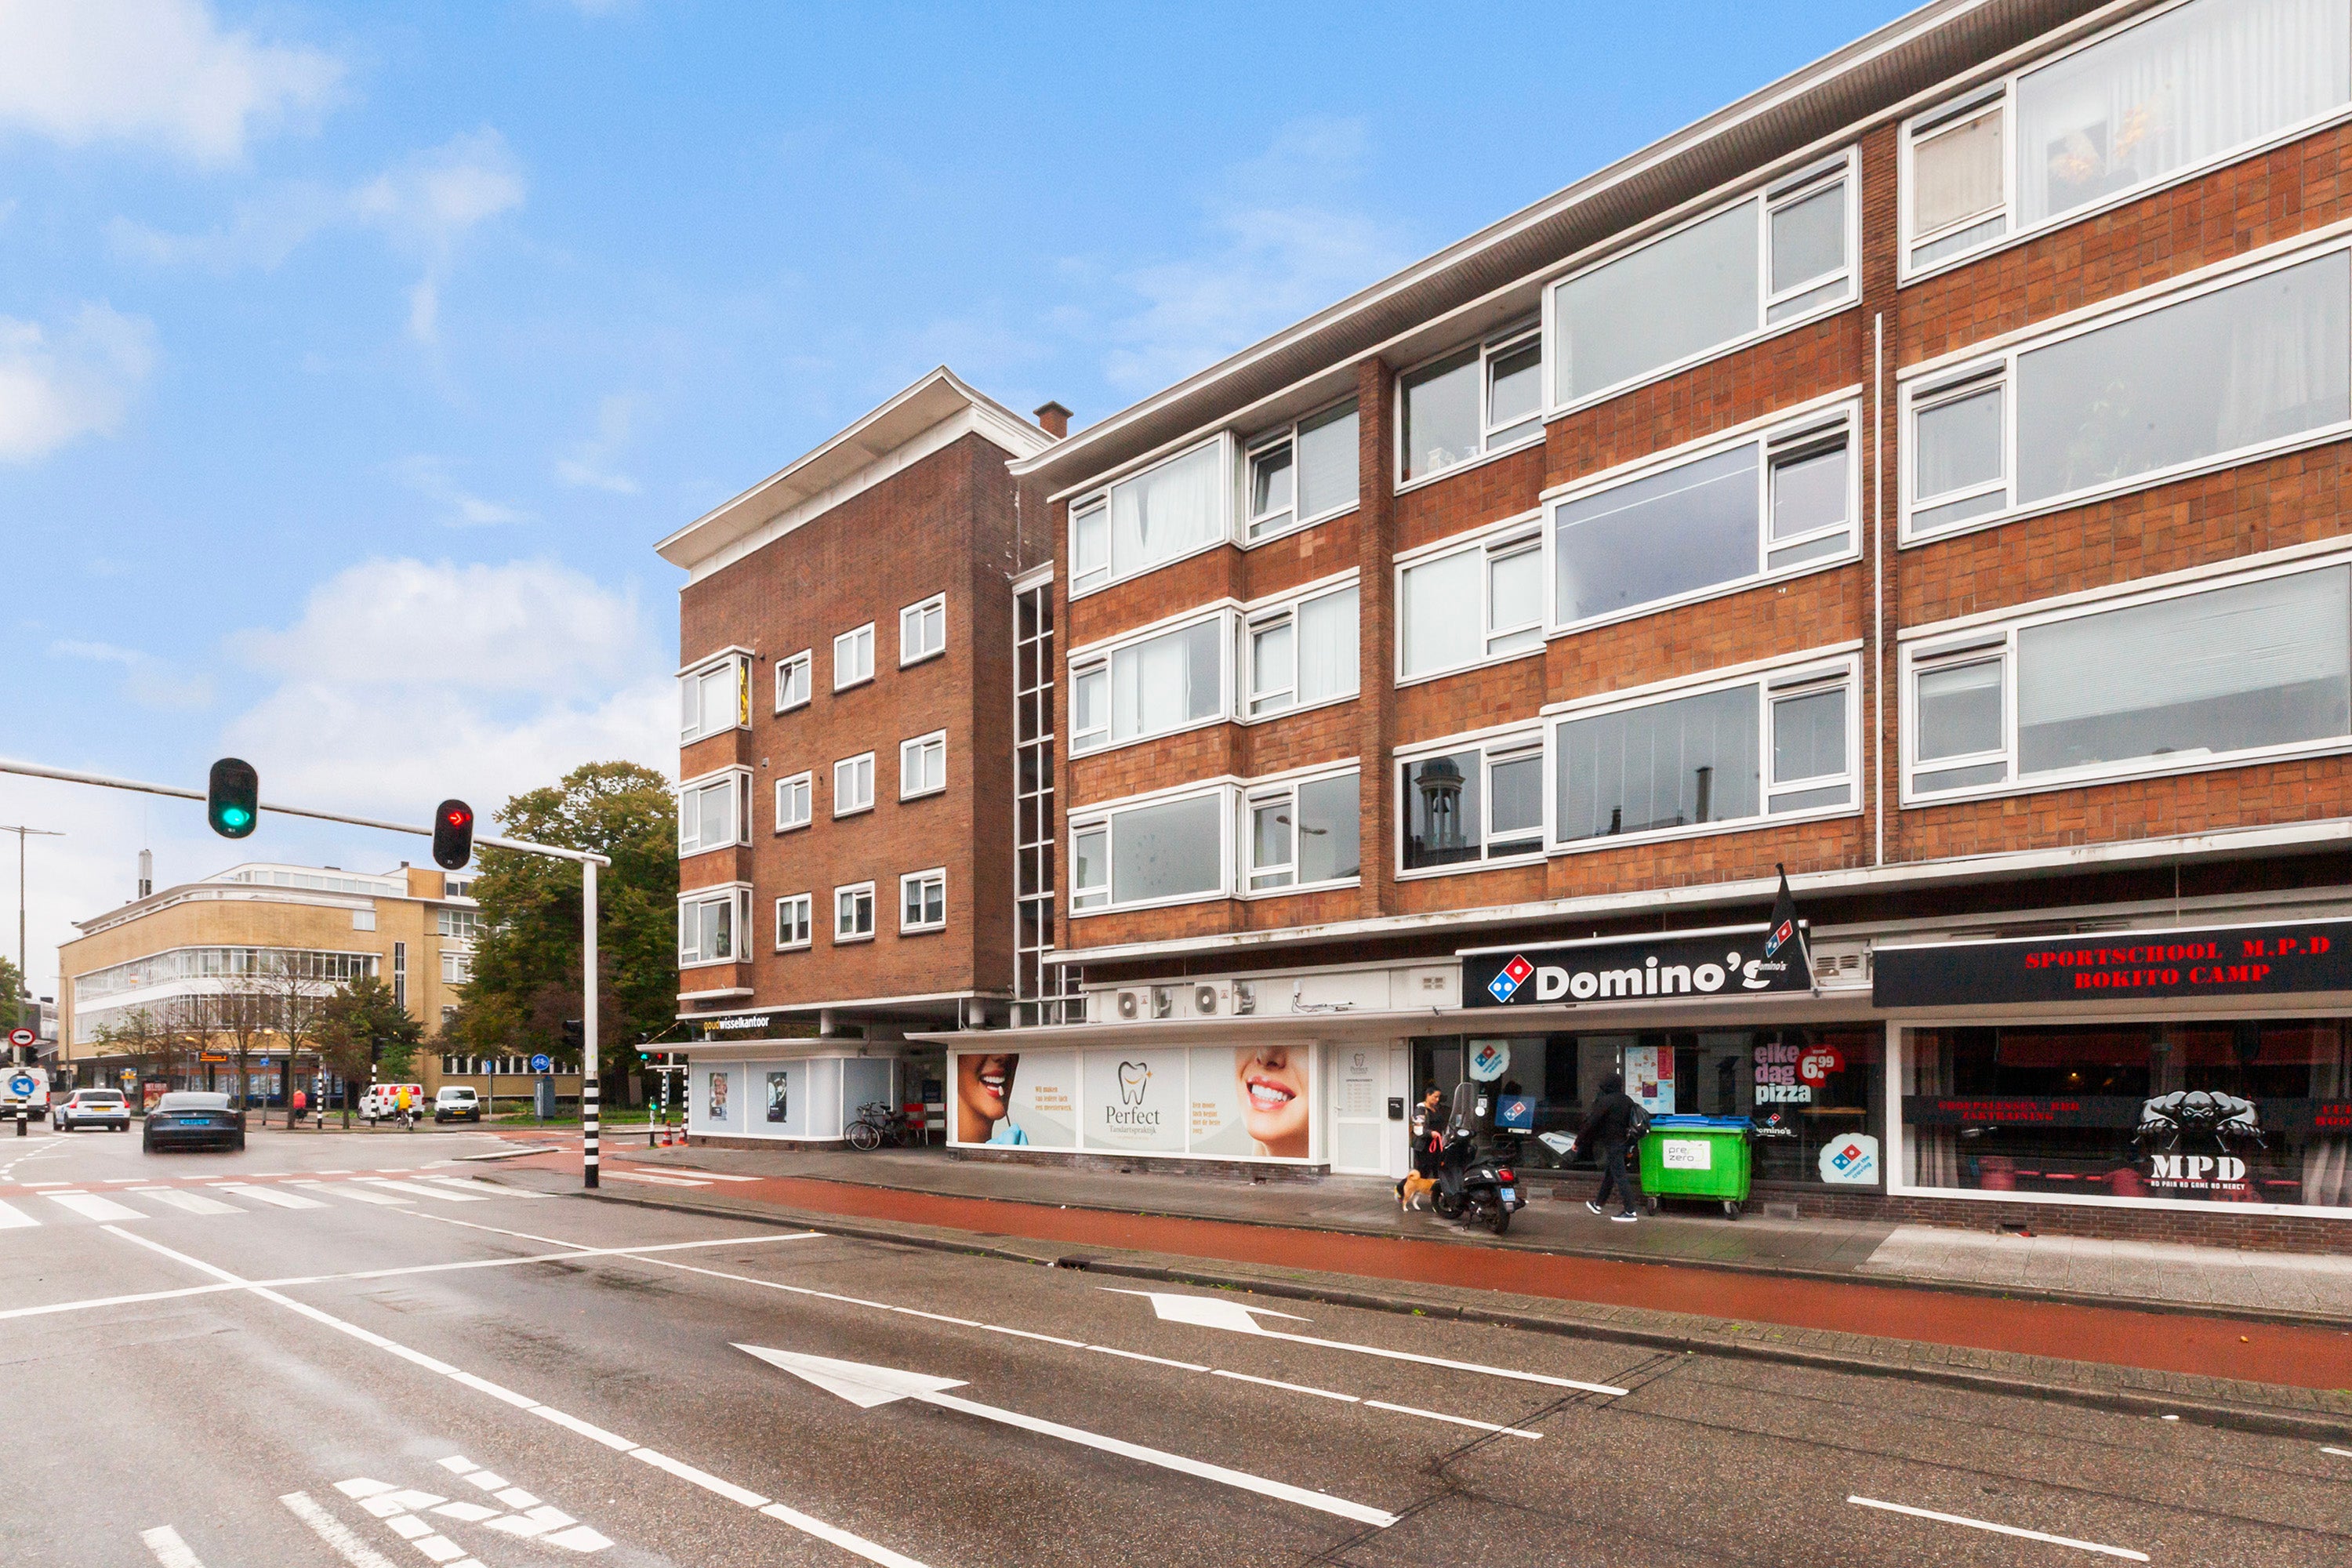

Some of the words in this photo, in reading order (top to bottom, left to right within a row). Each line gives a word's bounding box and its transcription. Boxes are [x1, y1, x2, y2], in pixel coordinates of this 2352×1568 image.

[2025, 942, 2223, 969] SPORTSCHOOL
[2242, 936, 2331, 958] M.P.D
[1536, 952, 1770, 1001] Domino's
[2074, 968, 2180, 989] BOKITO
[2189, 964, 2270, 985] CAMP
[703, 1016, 770, 1032] goudwisselkantoor
[1754, 1044, 1800, 1063] elke
[1755, 1063, 1795, 1085] dag
[1755, 1083, 1812, 1105] pizza
[1105, 1105, 1160, 1125] Perfect
[2151, 1155, 2246, 1181] MPD
